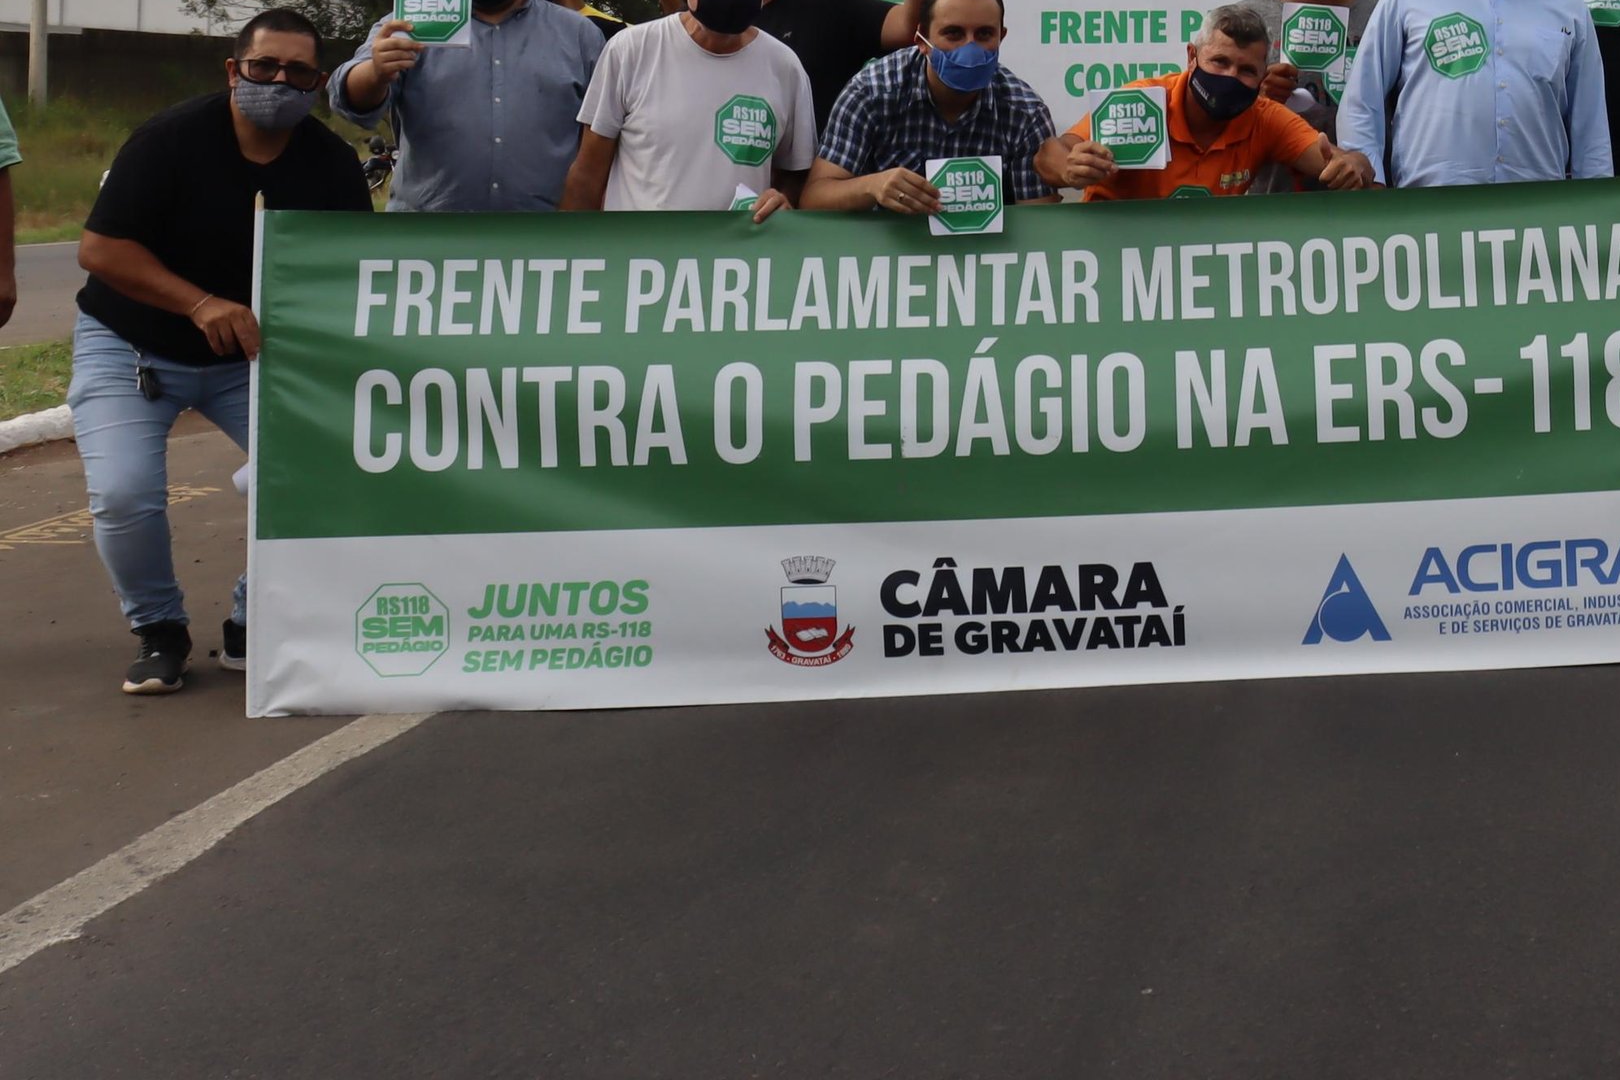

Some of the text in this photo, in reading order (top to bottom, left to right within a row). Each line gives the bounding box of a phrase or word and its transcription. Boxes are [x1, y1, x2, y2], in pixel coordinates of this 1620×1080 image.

[403, 10, 460, 23] PEDÁGIO
[1040, 10, 1168, 44] FRENTE
[1298, 16, 1332, 31] RS118
[1288, 28, 1339, 46] SEM
[1433, 21, 1469, 42] RS118
[1288, 43, 1338, 54] PEDÁGIO
[1430, 30, 1481, 59] SEM
[1436, 45, 1484, 68] PEDÁGIO
[732, 105, 768, 123] RS118
[1108, 102, 1146, 119] RS118
[722, 118, 772, 140] SEM
[1099, 117, 1157, 136] SEM
[722, 134, 771, 150] PEDÁGIO
[1100, 132, 1157, 146] PEDÁGIO
[946, 170, 985, 187] RS118
[938, 184, 995, 203] SEM
[354, 259, 606, 337] FRENTE
[624, 249, 1100, 334] PARLAMENTAR
[353, 364, 689, 474] CONTRA
[713, 361, 763, 465] O
[794, 336, 1147, 462] PEDÁGIO
[1174, 347, 1290, 450] NA
[880, 556, 1169, 619] CÂMARA
[376, 595, 430, 616] RS118
[467, 579, 650, 620] JUNTOS
[1403, 599, 1491, 620] ASSOCIAÇÃO
[1495, 597, 1579, 615] COMERCIAL,
[362, 615, 444, 639] SEM
[467, 620, 653, 642] PARA UMA RS-118
[882, 604, 1186, 658] DE GRAVATAÍ
[1439, 621, 1447, 635] E
[1451, 620, 1469, 634] DE
[1473, 615, 1541, 634] SERVIÇOS
[1545, 615, 1562, 629] DE
[362, 637, 444, 654] PEDÁGIO
[462, 641, 653, 673] SEM PEDÁGIO
